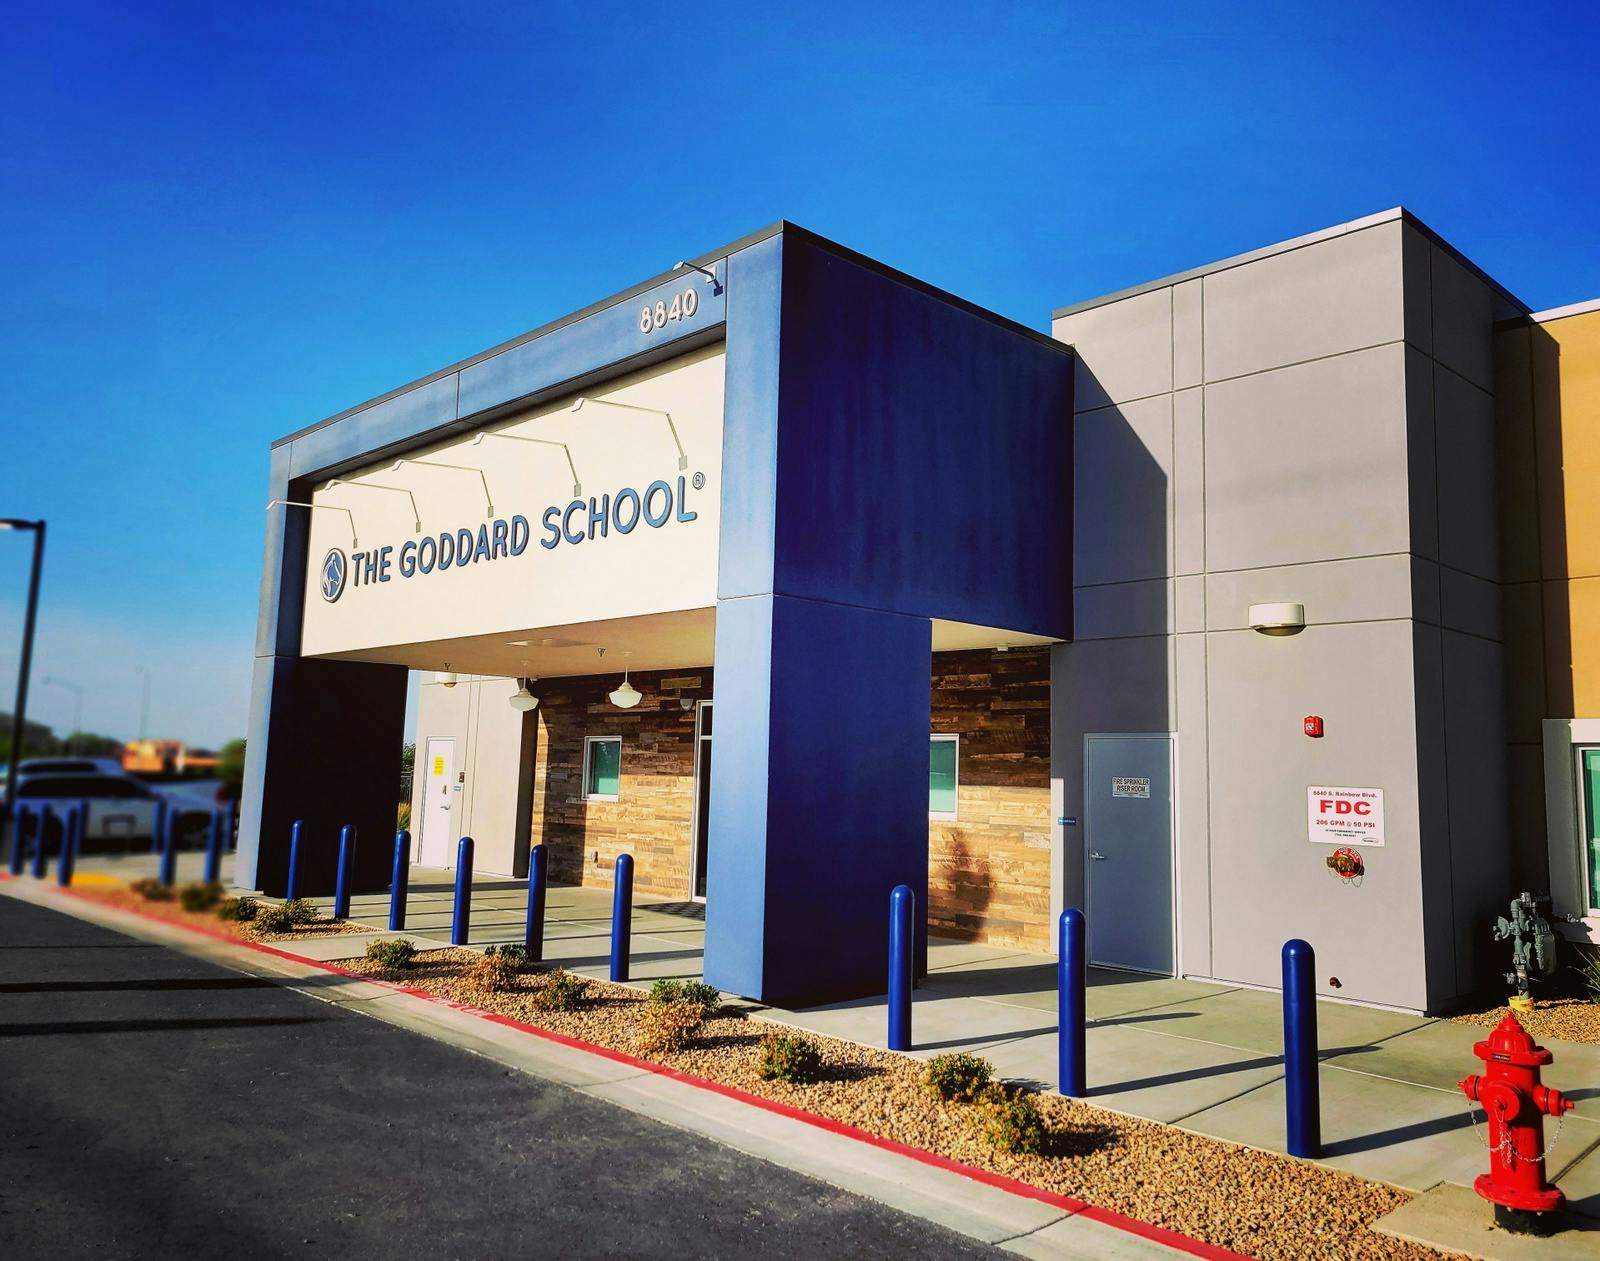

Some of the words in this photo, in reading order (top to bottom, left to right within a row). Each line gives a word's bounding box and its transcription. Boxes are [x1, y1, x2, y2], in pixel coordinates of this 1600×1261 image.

[640, 288, 698, 334] 8840
[352, 546, 393, 587] THE
[399, 515, 530, 578] GODDARD
[1320, 799, 1371, 816] FDC
